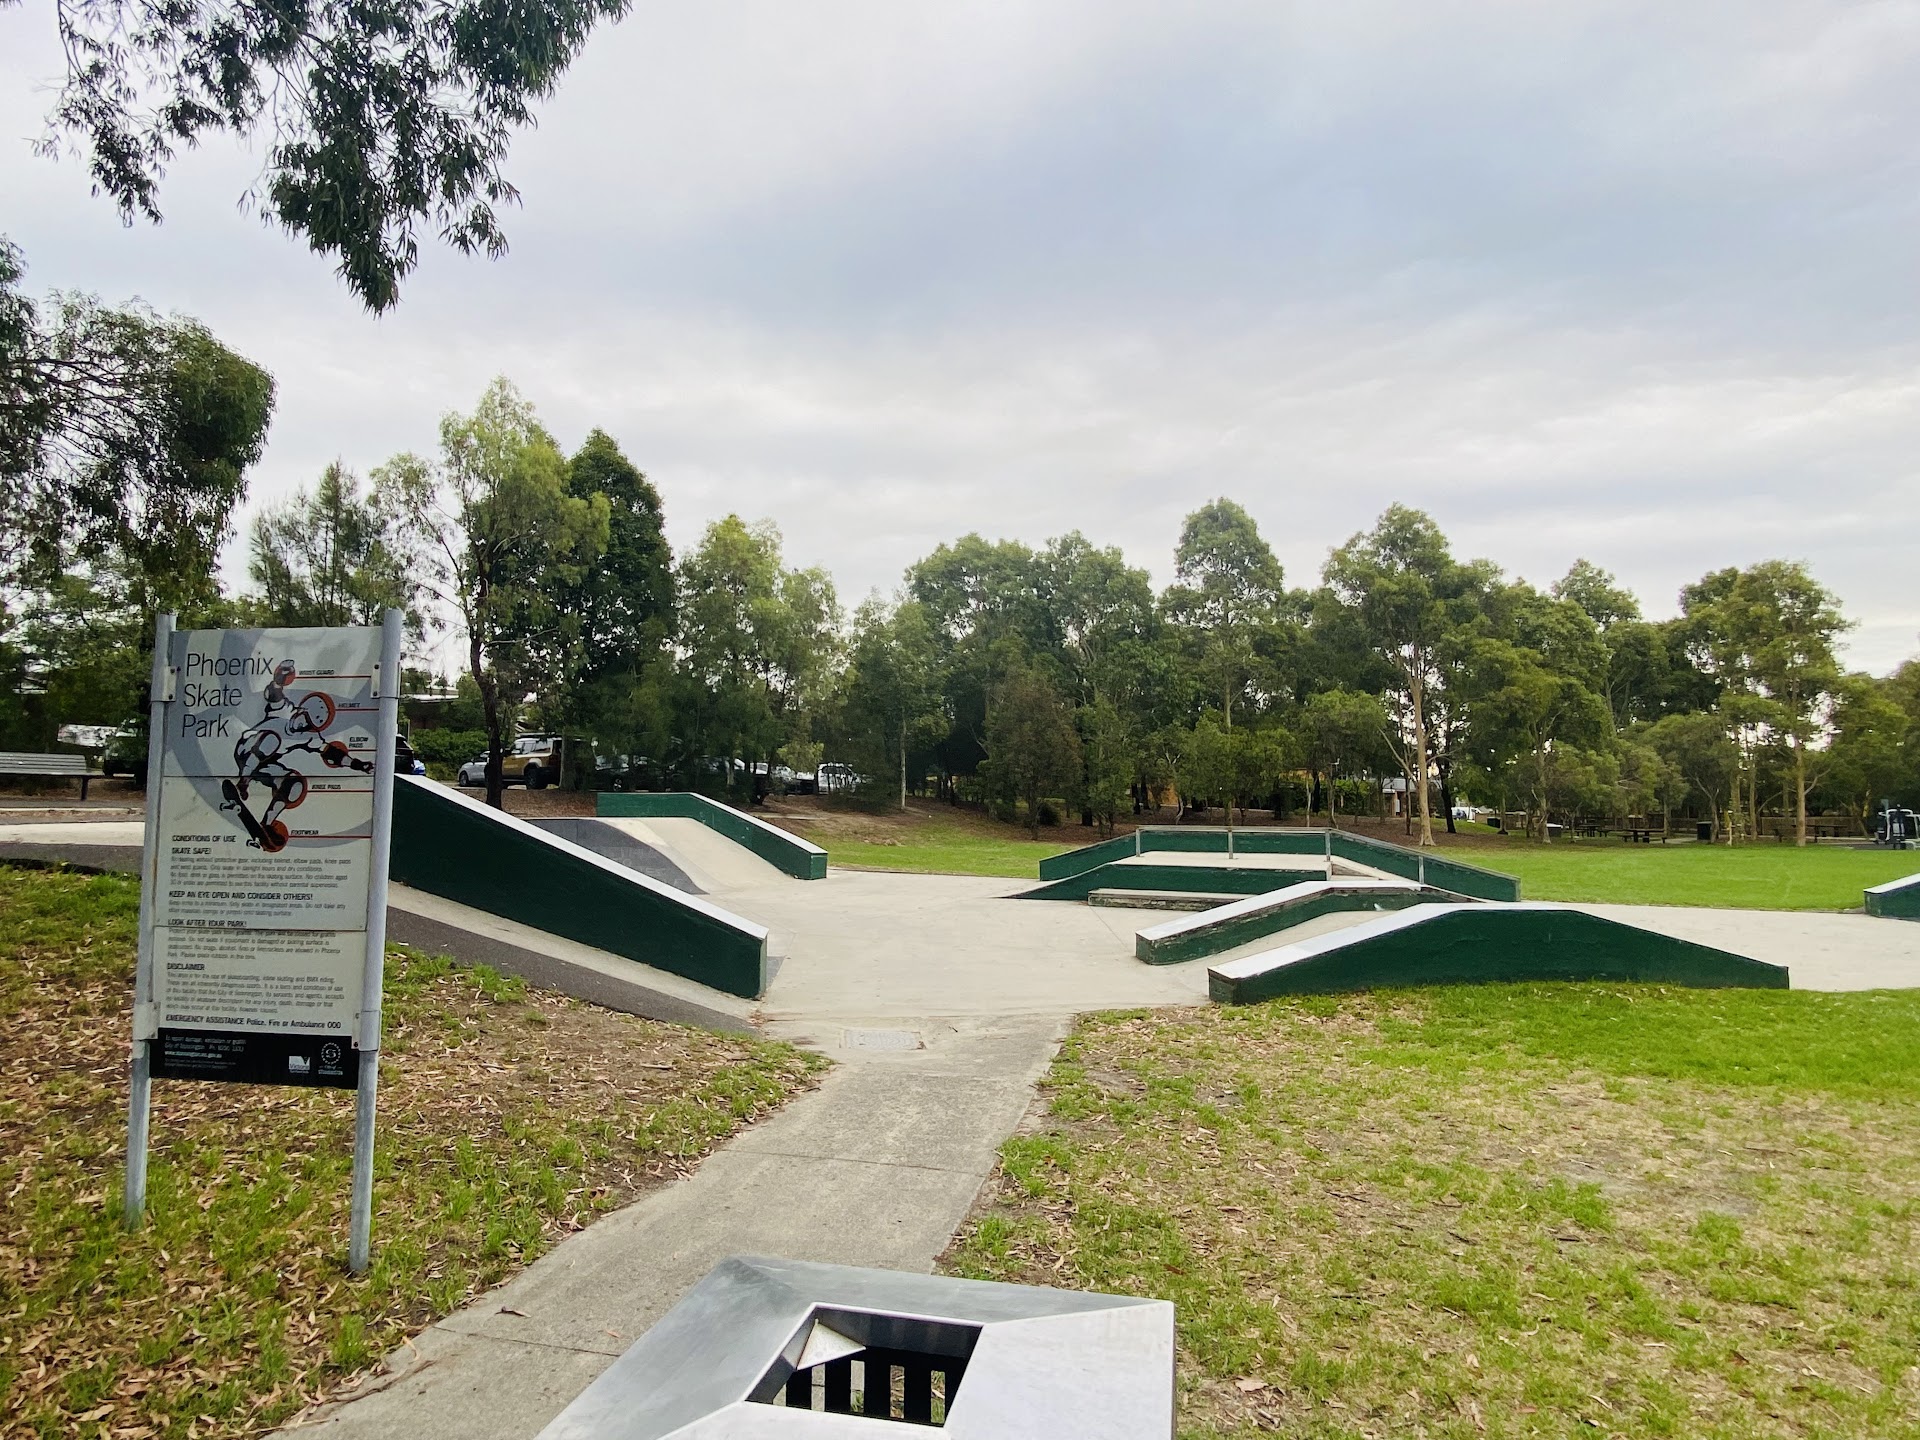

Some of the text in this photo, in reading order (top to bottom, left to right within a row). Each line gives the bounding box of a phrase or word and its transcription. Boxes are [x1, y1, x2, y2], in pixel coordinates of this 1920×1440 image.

[186, 651, 273, 676] Phoenix
[183, 683, 242, 707] Skate
[181, 714, 230, 738] Park
[168, 890, 185, 898] KEEP
[197, 891, 211, 899] EYE
[211, 891, 230, 899] OPEN
[231, 891, 246, 899] AND
[247, 892, 282, 900] CONSIDER
[282, 893, 313, 901] OTHERS!
[167, 918, 248, 928] LOOK AFTER YOUR PARK!
[165, 1014, 205, 1024] EMERGENCY
[205, 1015, 245, 1025] ASSISTANCE
[268, 1018, 281, 1027] Fire
[289, 1019, 326, 1028] Ambulance
[326, 1020, 342, 1029] 000
